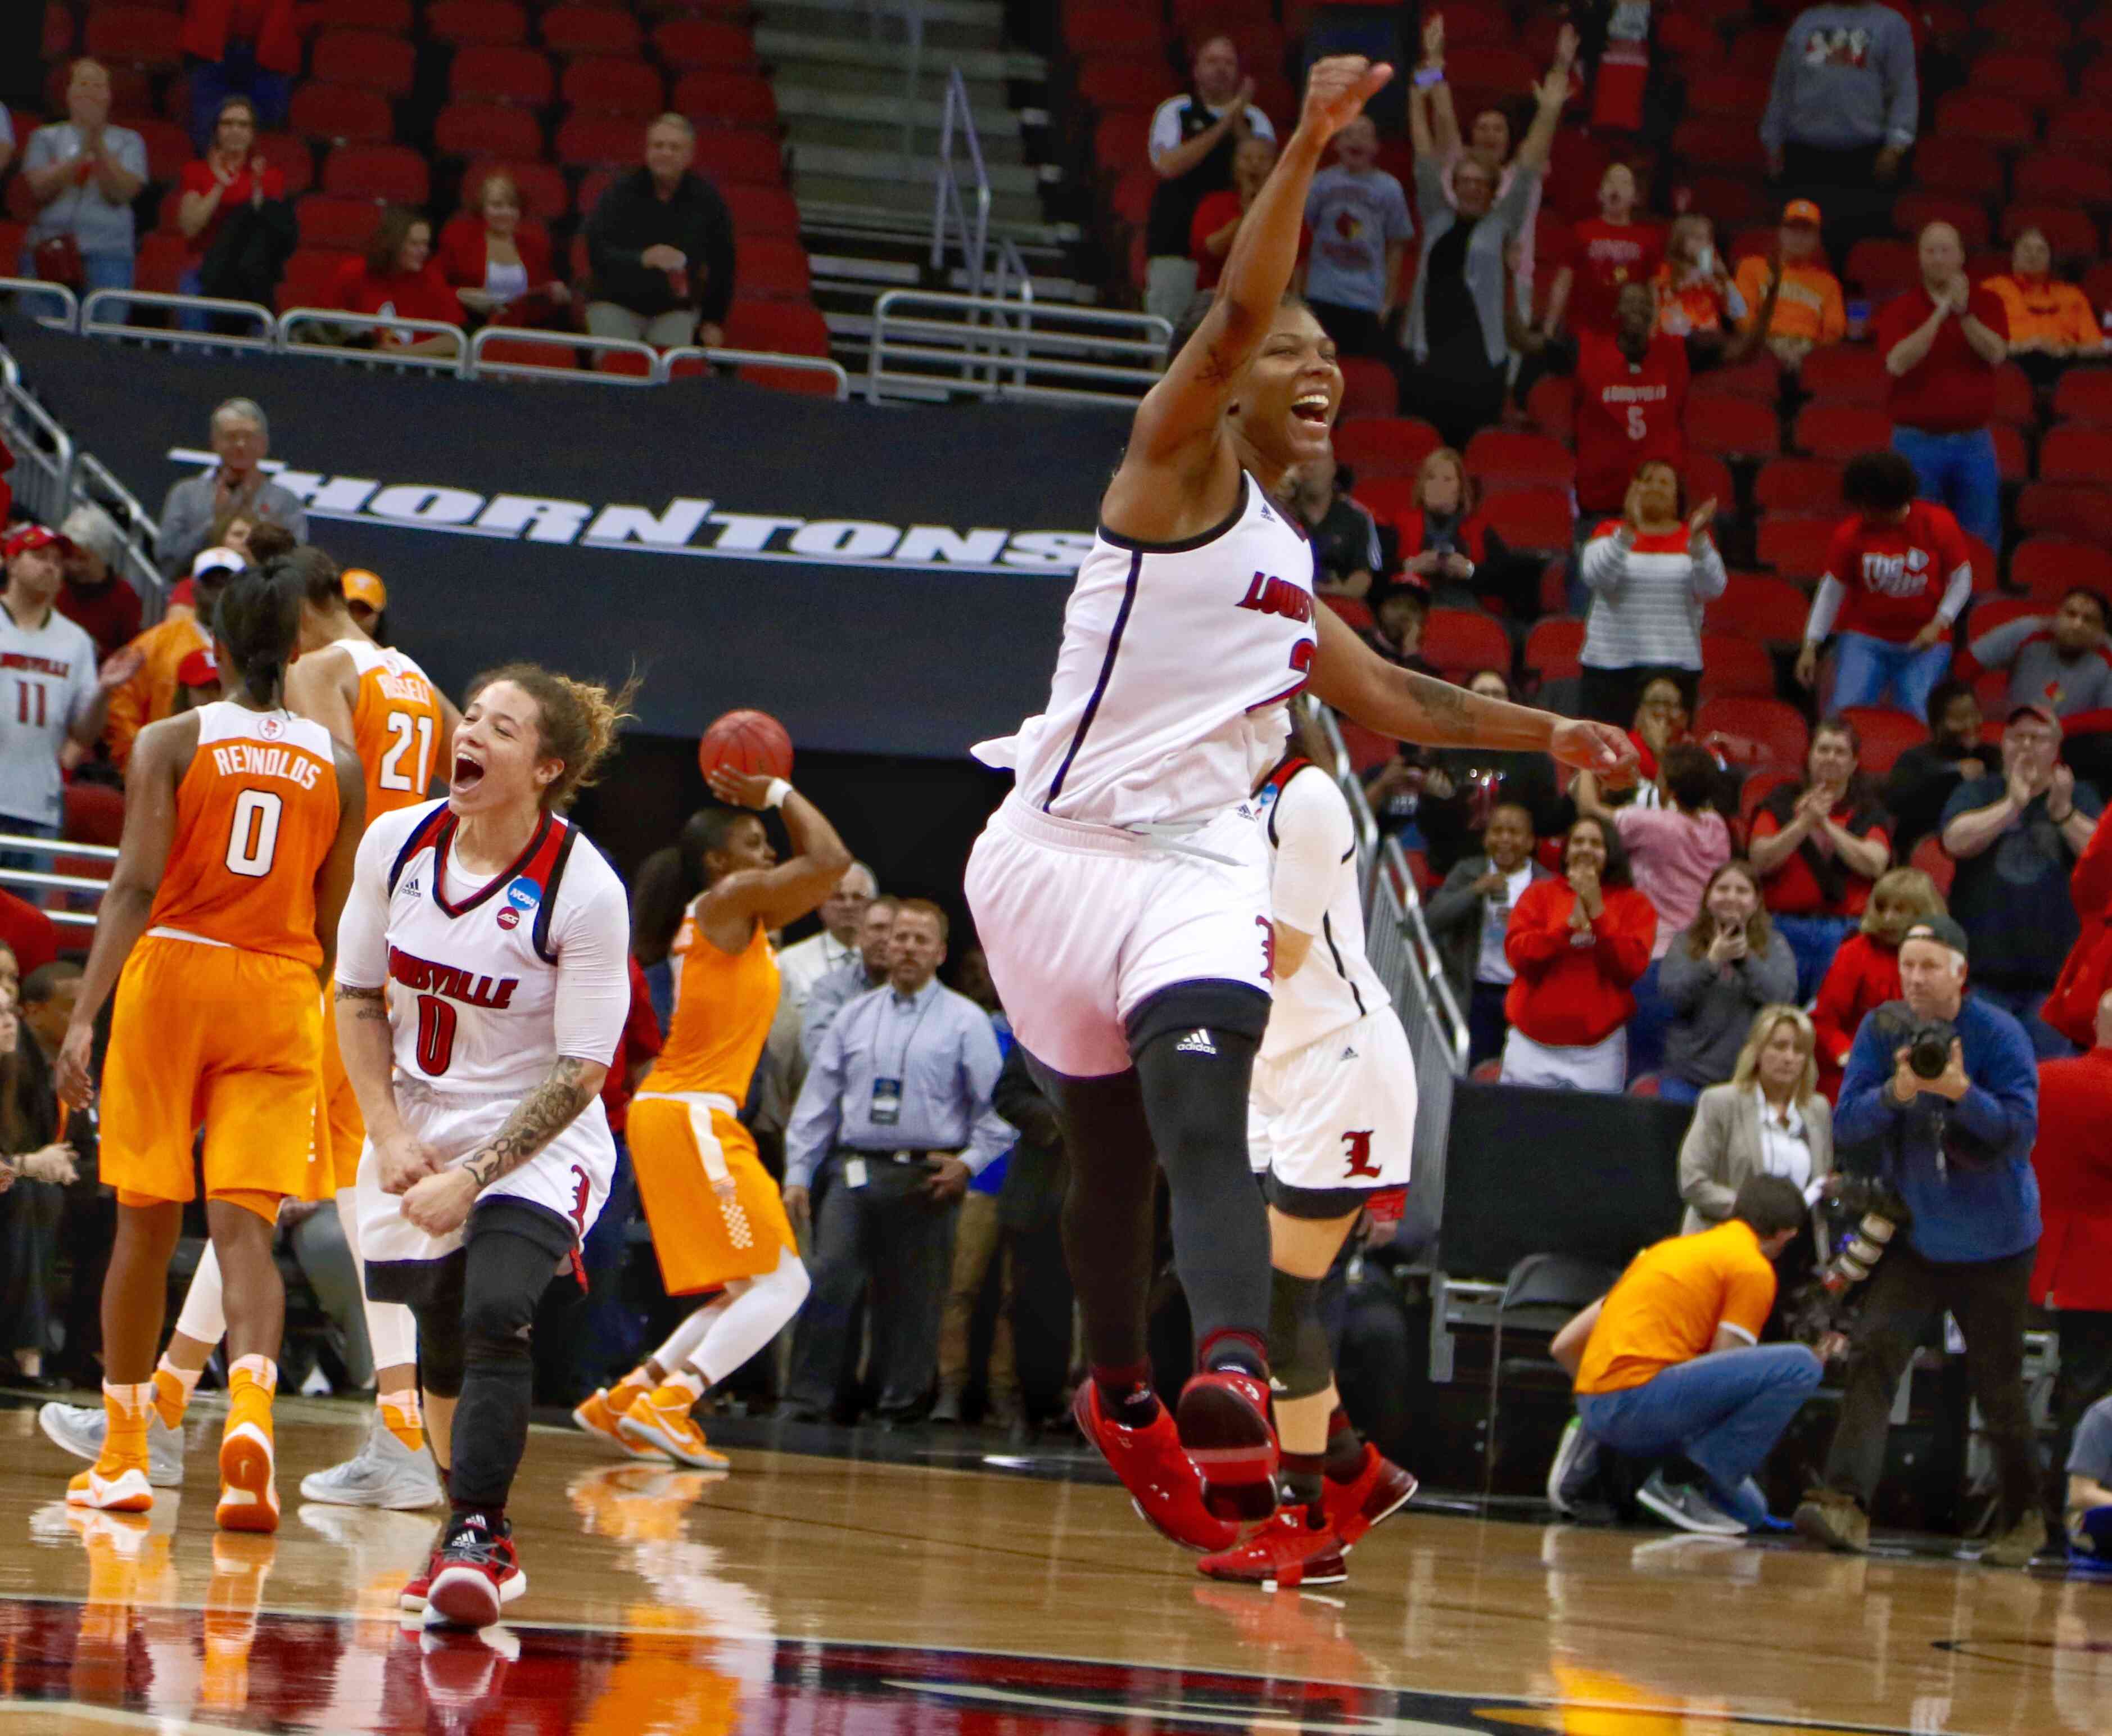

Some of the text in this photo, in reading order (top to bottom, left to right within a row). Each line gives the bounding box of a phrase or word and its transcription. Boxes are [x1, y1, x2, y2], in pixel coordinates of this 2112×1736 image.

[1628, 405, 1647, 440] 5
[17, 681, 46, 727] 11
[212, 744, 322, 790] REYNOLDS
[380, 711, 432, 795] 21
[225, 788, 283, 878] 0
[400, 888, 421, 897] adidas
[510, 888, 537, 908] NCAA
[417, 994, 456, 1077] 0
[1177, 1042, 1216, 1055] adidas
[1341, 1129, 1383, 1179] L
